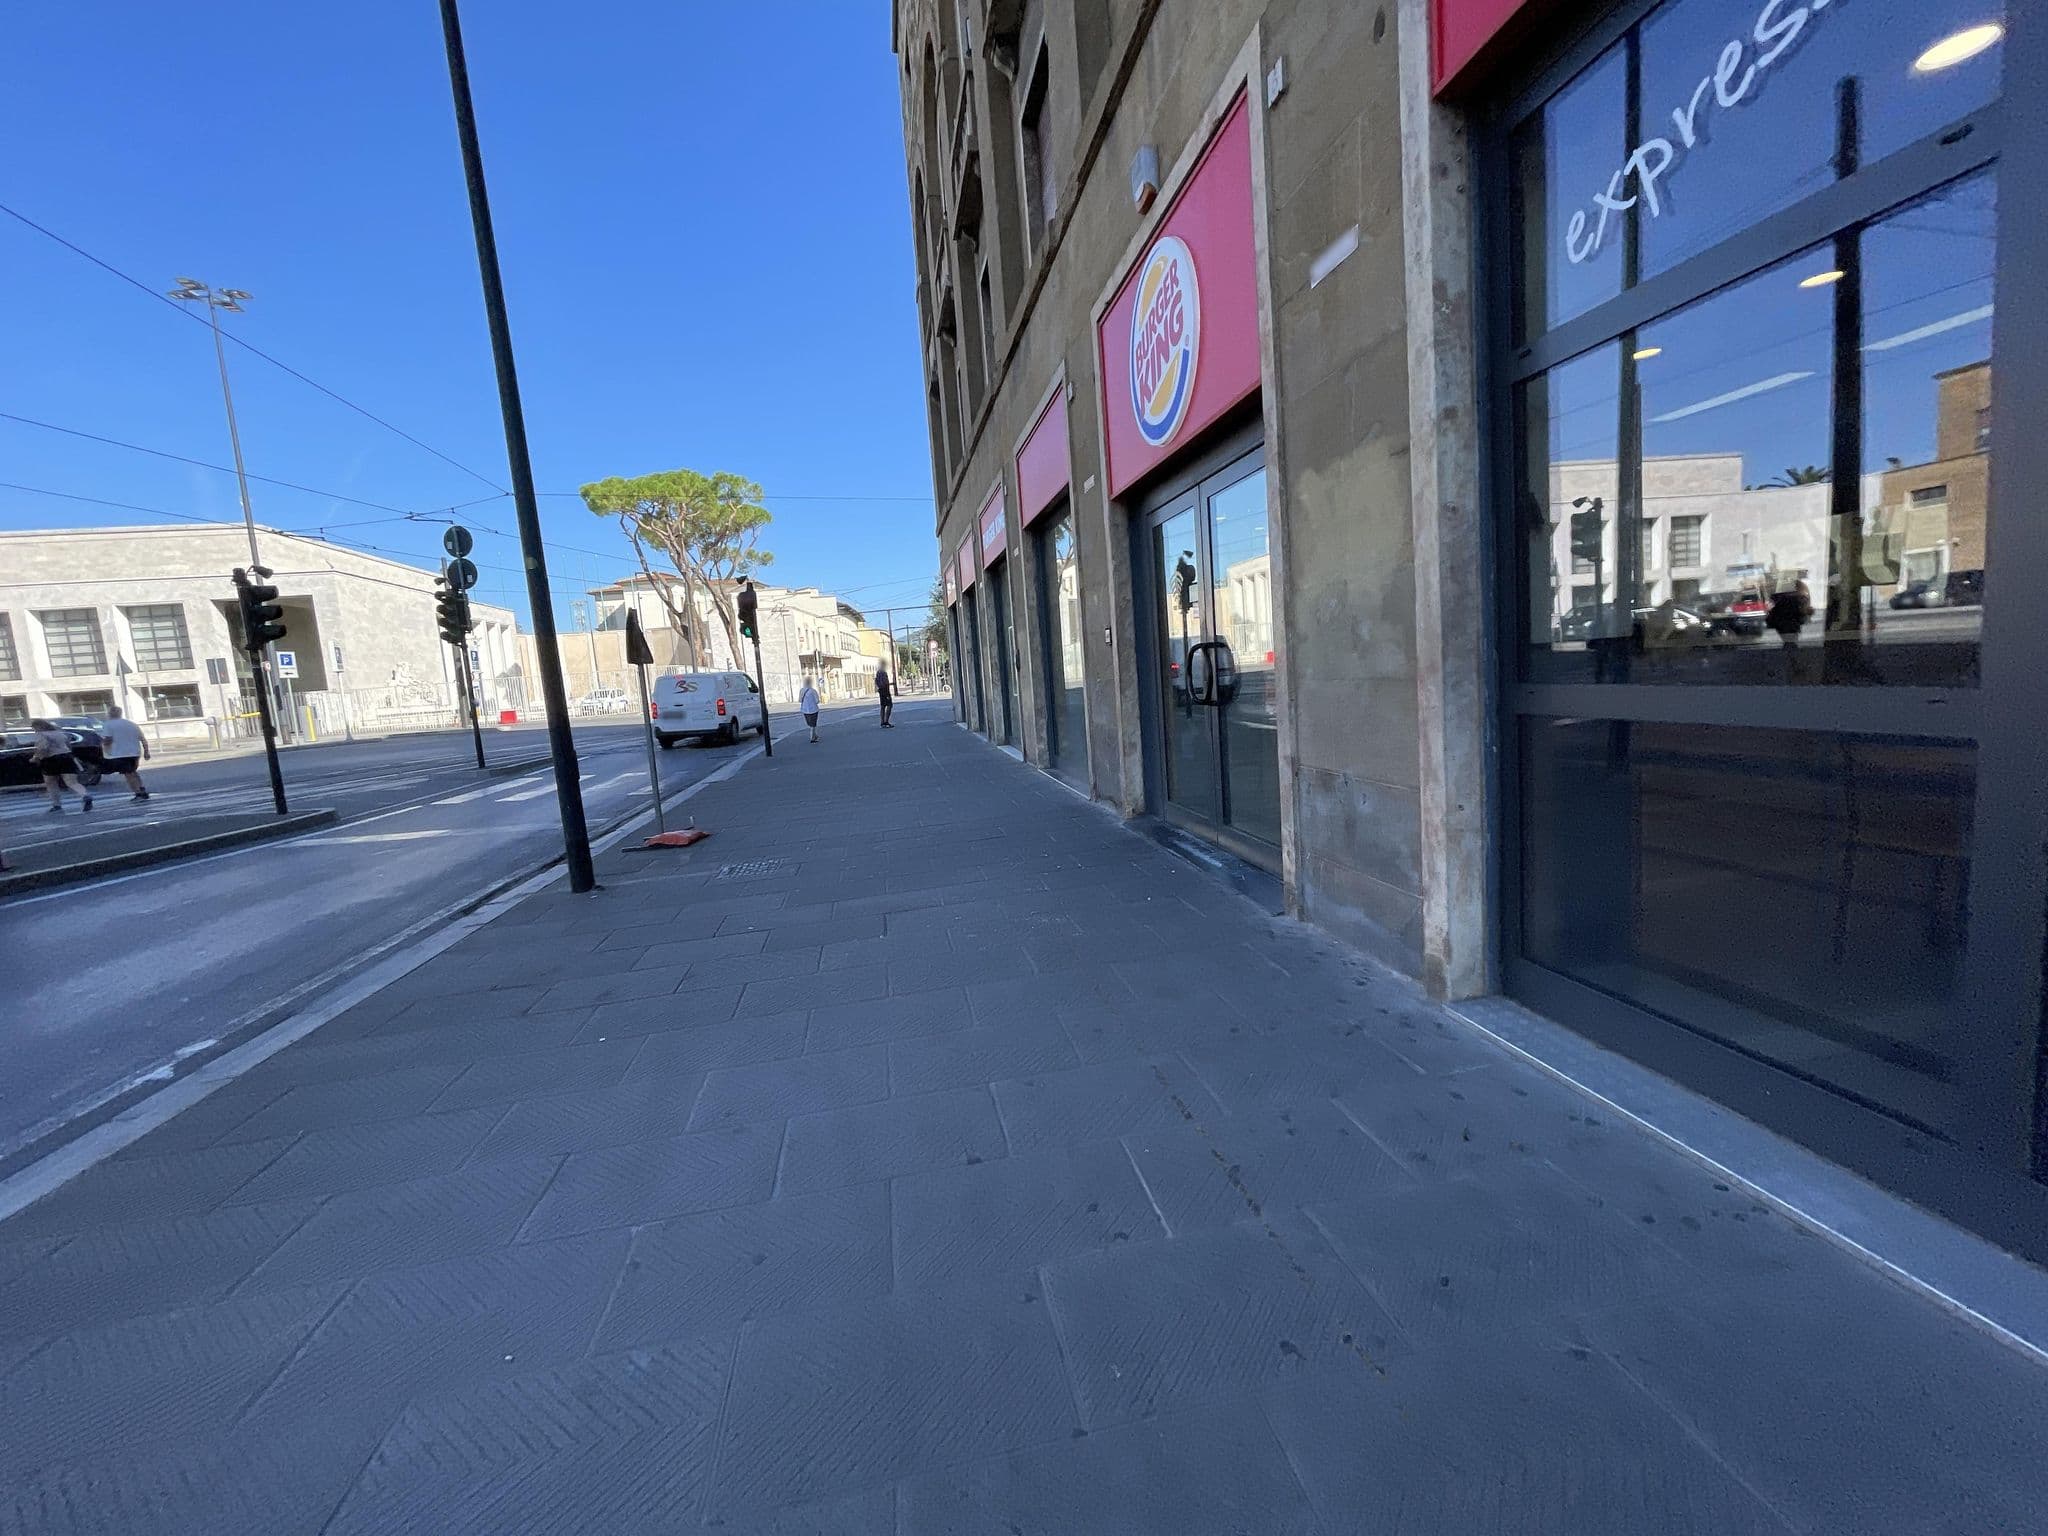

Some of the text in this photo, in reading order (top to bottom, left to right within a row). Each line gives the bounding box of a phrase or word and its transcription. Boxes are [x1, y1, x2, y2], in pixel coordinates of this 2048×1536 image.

[1566, 0, 1830, 263] expres
[1135, 258, 1180, 382] BURGER
[1137, 289, 1184, 422] KING
